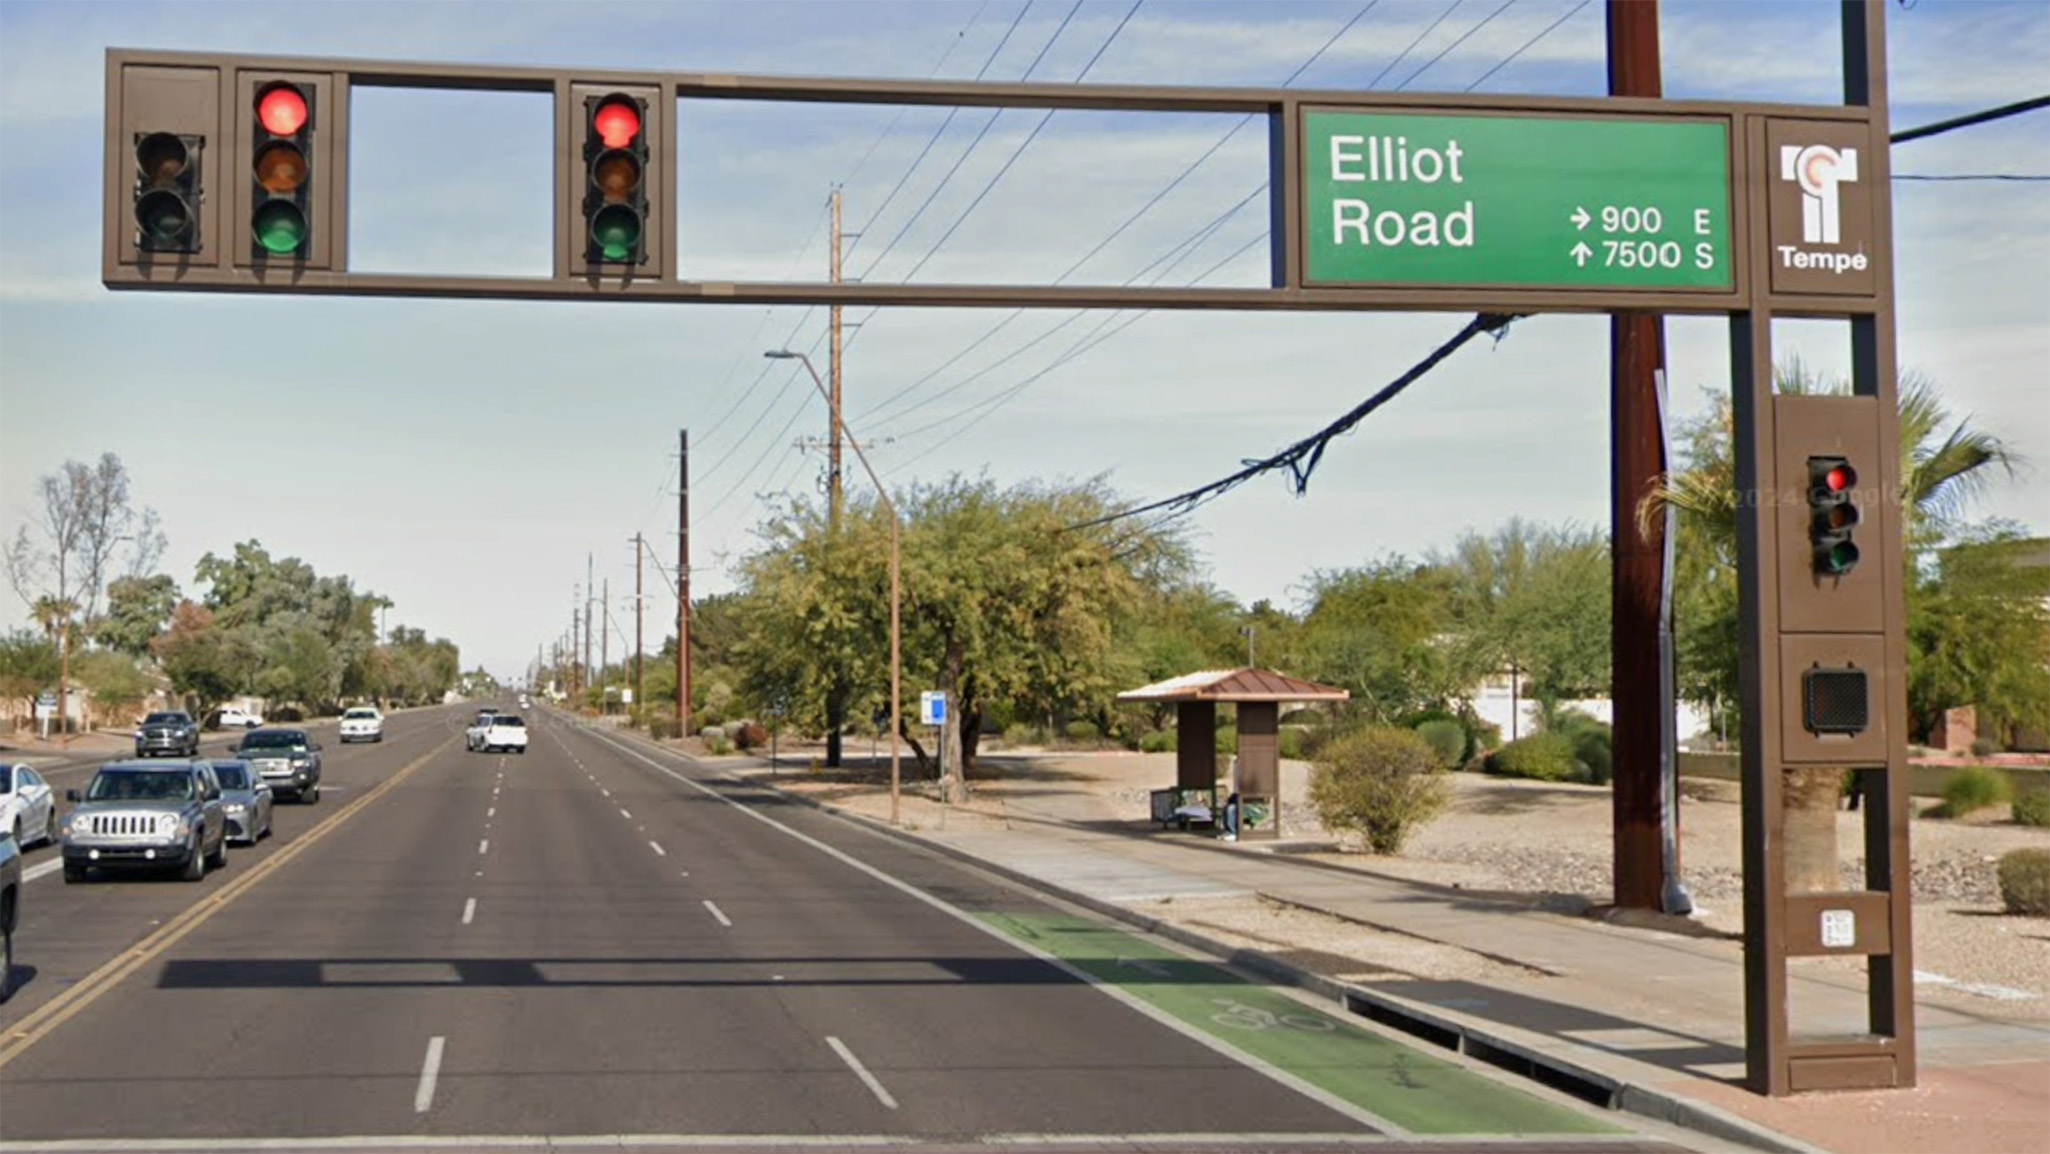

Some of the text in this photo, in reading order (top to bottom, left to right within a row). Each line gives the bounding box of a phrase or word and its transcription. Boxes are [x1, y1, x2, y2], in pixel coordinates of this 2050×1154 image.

[1330, 135, 1464, 183] Elliot
[1333, 198, 1474, 247] Road
[1602, 205, 1711, 234] 900 E
[1602, 241, 1714, 269] 7500 S
[1777, 245, 1868, 274] Tempe
